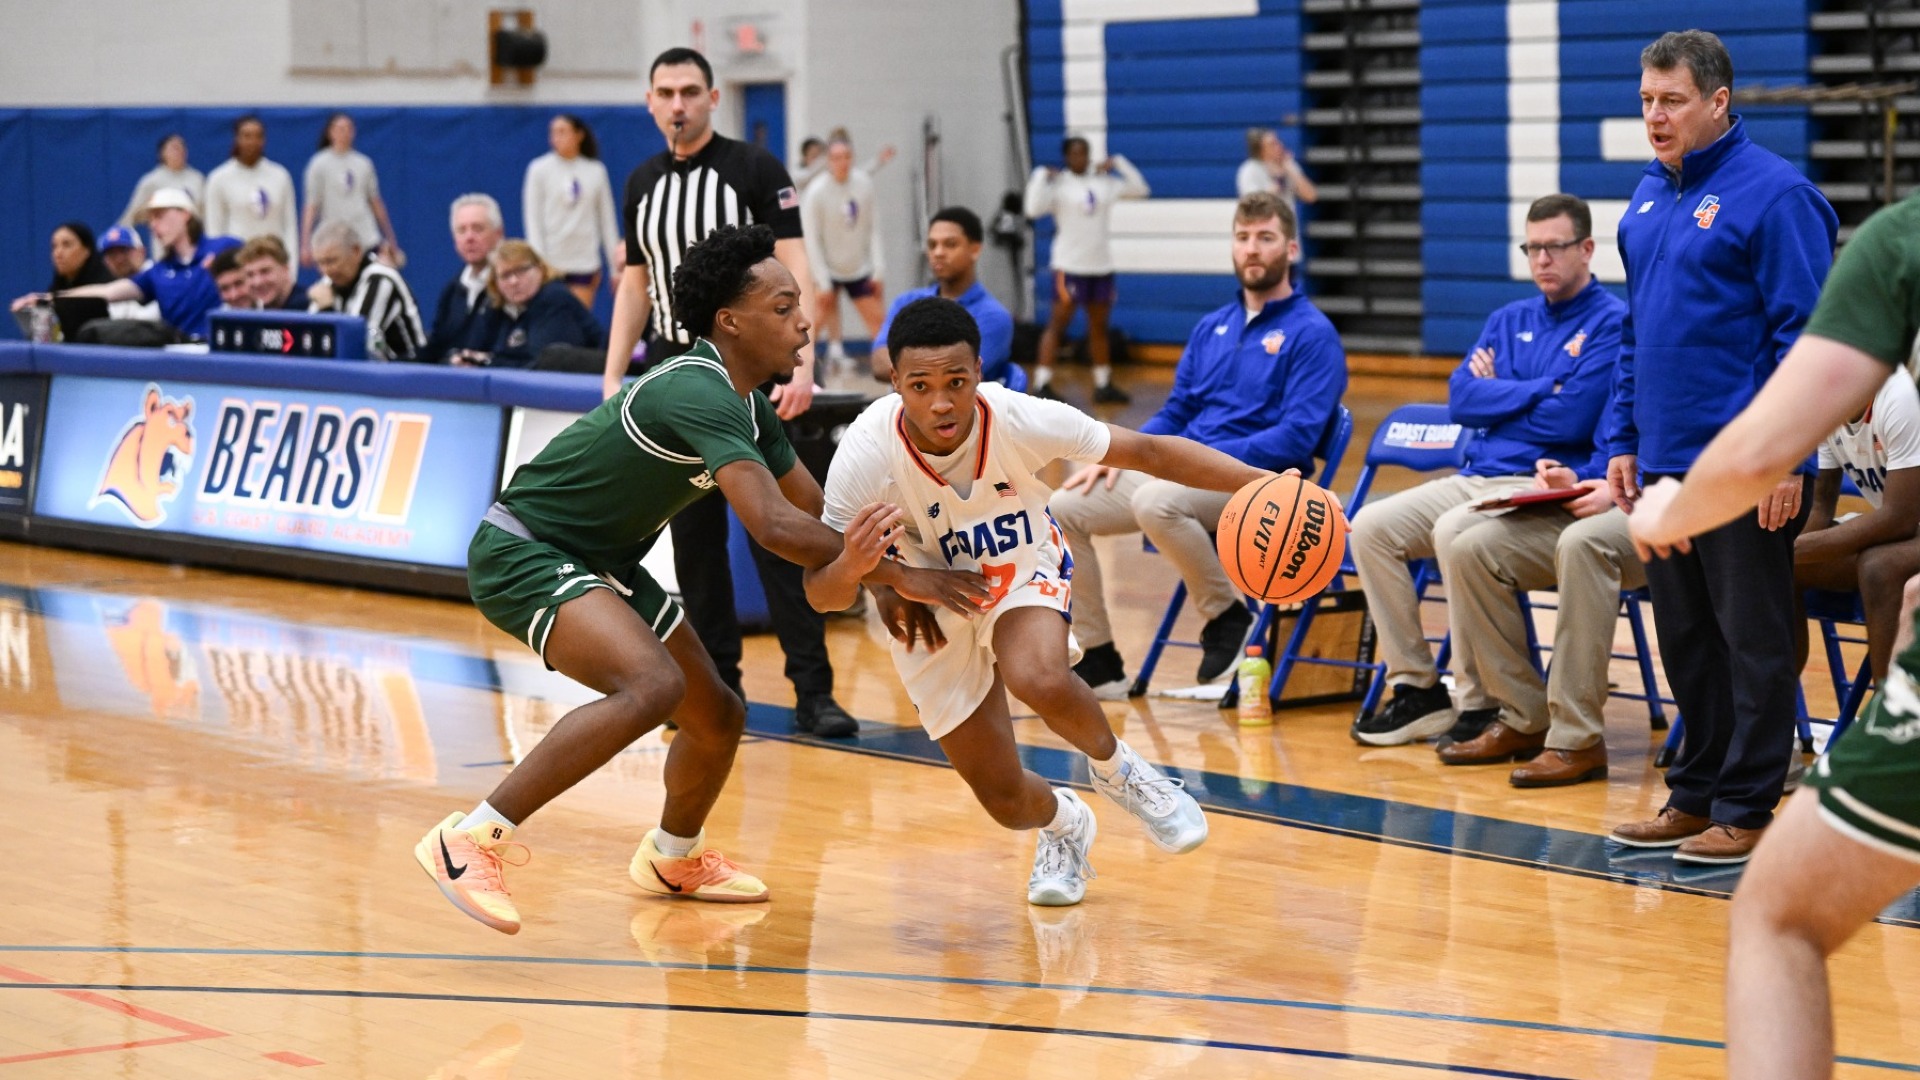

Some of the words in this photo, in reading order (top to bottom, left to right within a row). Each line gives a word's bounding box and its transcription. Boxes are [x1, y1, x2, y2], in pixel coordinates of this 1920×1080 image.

[203, 406, 374, 509] BEARS
[1386, 422, 1427, 441] COAST
[939, 510, 1033, 566] COAST
[1281, 499, 1326, 580] Wilson
